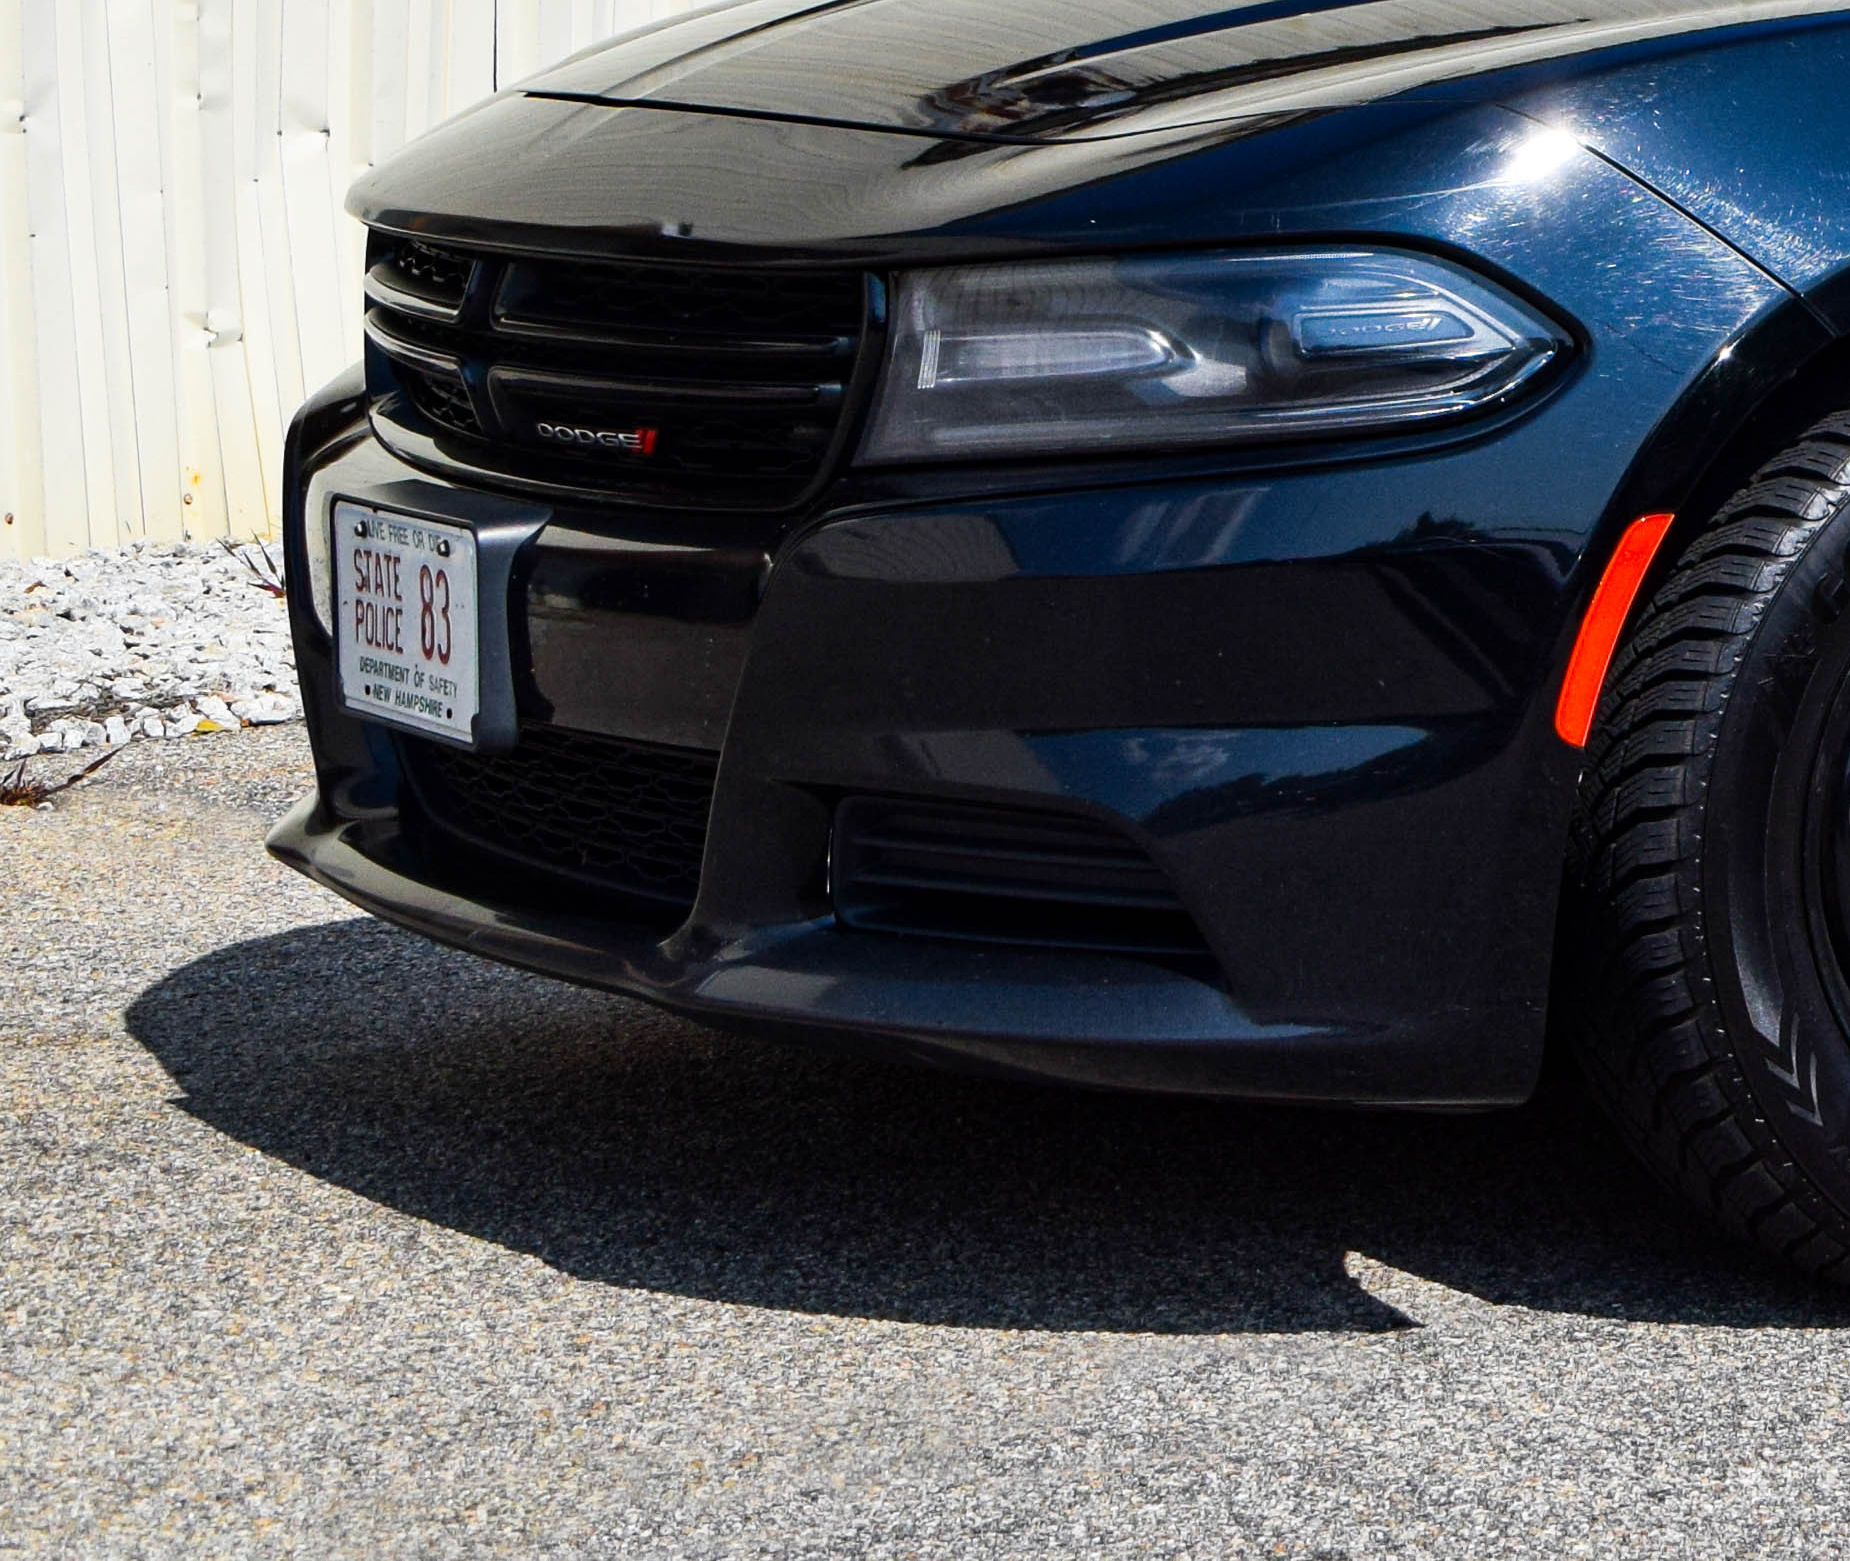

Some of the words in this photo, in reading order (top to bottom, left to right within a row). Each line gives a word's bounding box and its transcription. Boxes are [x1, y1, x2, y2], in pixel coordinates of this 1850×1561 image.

[537, 422, 643, 449] DODGE
[388, 524, 410, 546] FREE
[412, 529, 426, 549] OR
[353, 548, 402, 601] STATE
[355, 599, 404, 654] POLICE
[419, 564, 451, 664] 83
[359, 656, 410, 685] DEPARTMENT
[413, 670, 425, 688] OF
[428, 675, 458, 697] SAFETY
[373, 683, 392, 703] NEW
[395, 690, 443, 718] HAMPSHIRE
